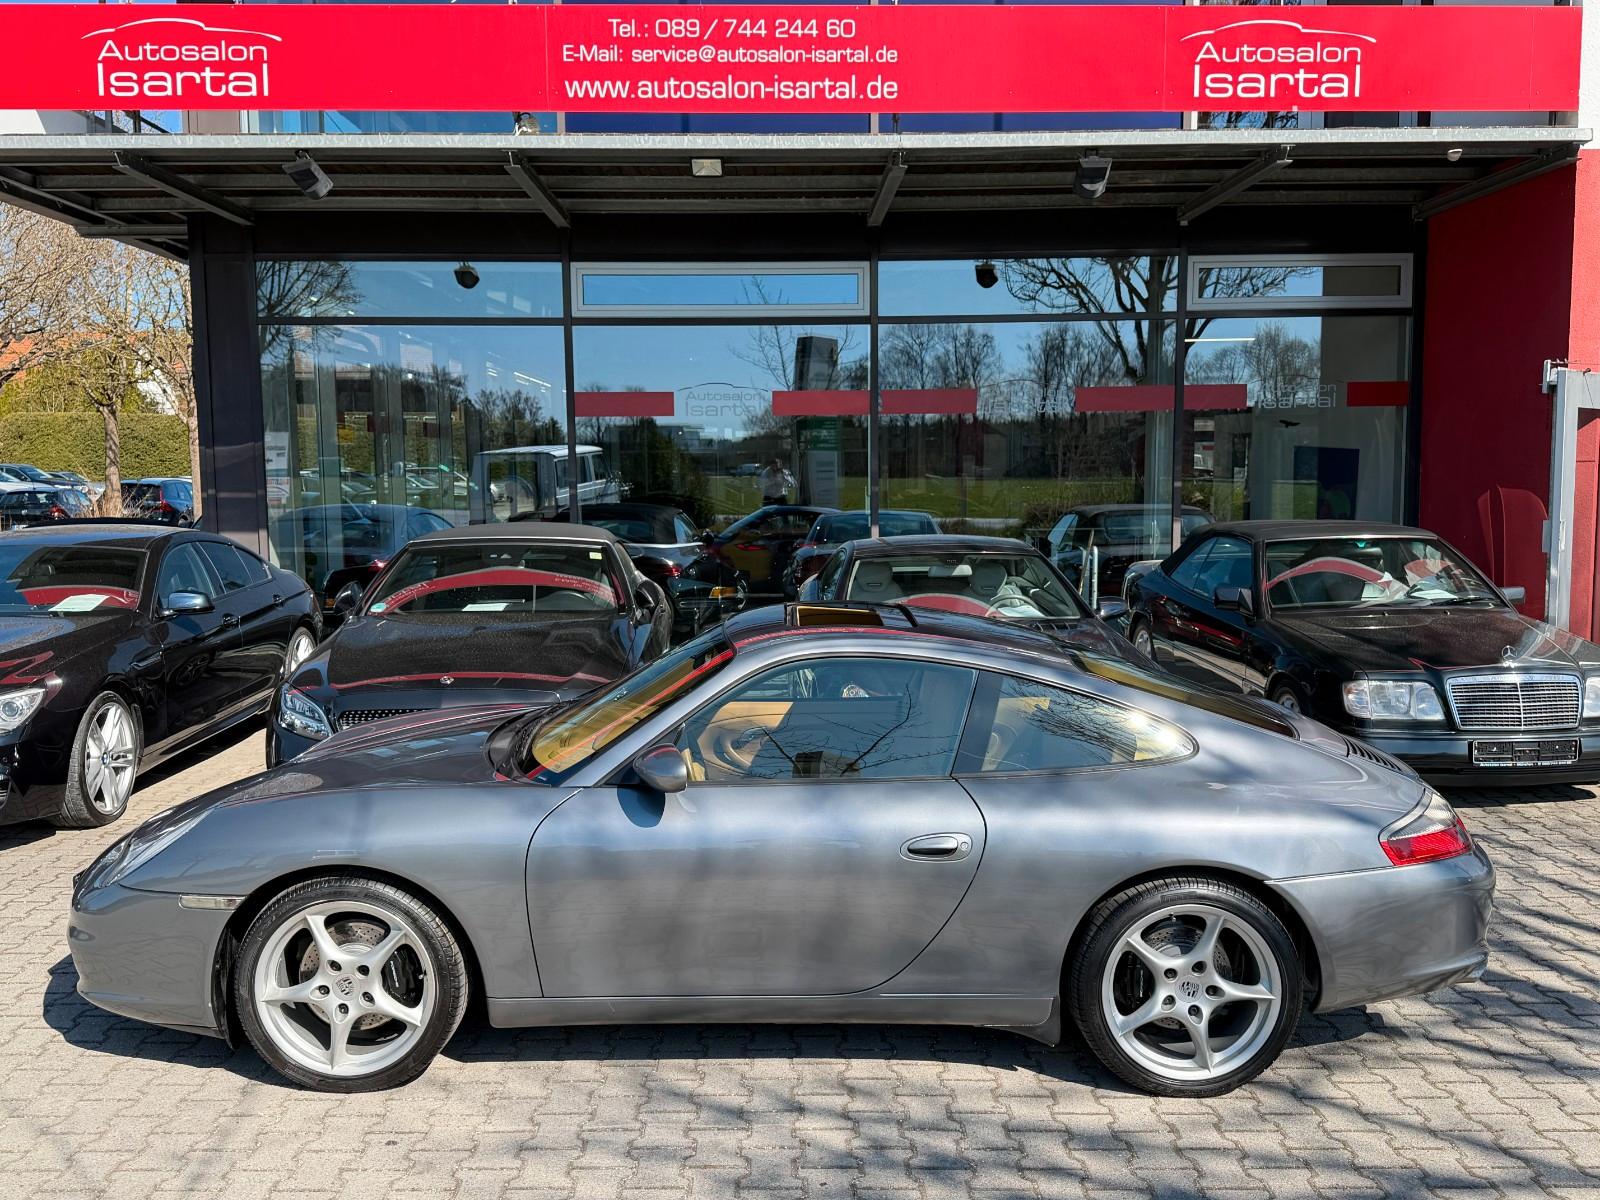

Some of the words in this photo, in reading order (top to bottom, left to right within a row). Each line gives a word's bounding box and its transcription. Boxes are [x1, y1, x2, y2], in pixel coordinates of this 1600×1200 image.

[608, 18, 648, 38] Tel.:
[655, 18, 700, 38] 089
[725, 19, 768, 38] 744
[775, 19, 819, 38] 244
[826, 19, 856, 38] 60
[97, 39, 268, 61] Autosalon
[562, 45, 623, 62] E-Mail:
[631, 44, 898, 63] service@autosalon-isartal.de
[1195, 41, 1361, 63] Autosalon
[97, 63, 269, 97] Isartal
[564, 74, 898, 99] www.autosalon-isartal.de
[1193, 64, 1361, 98] Isartal
[686, 391, 763, 401] Autosalon
[685, 401, 762, 416] Isartal
